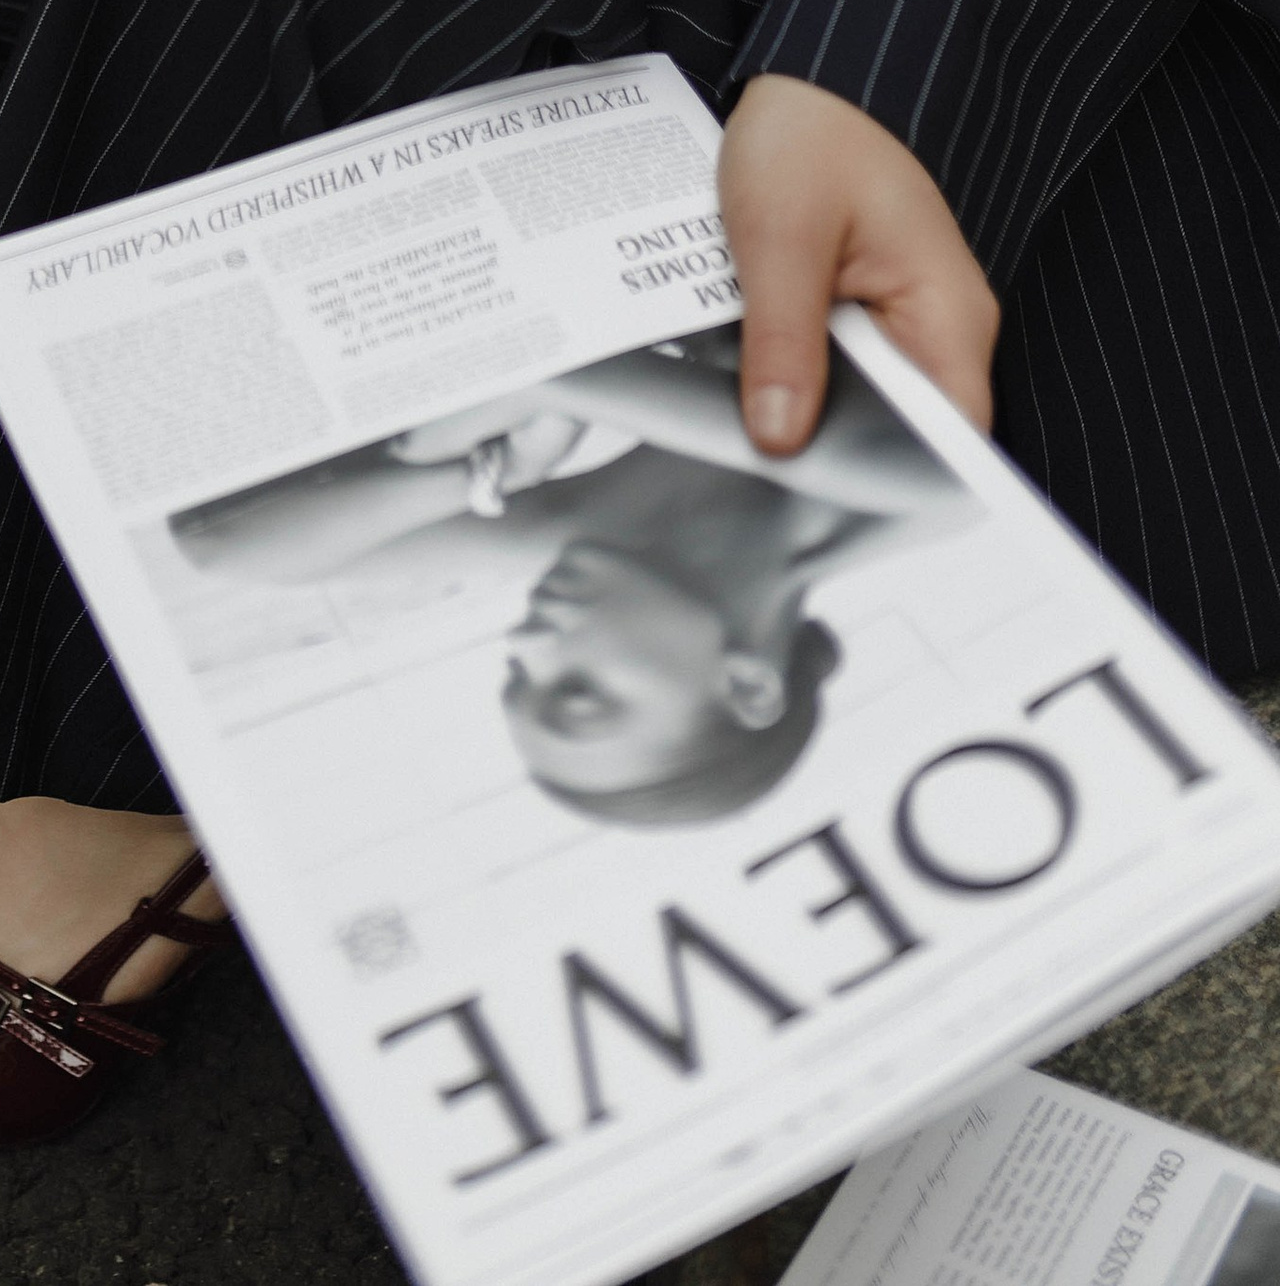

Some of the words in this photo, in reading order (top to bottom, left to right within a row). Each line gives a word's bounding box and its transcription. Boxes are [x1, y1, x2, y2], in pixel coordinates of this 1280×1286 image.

[527, 84, 650, 127] TEXTURE
[395, 143, 423, 170] IN
[426, 111, 525, 159] SPEAKS
[369, 153, 387, 177] A
[208, 160, 367, 233] WHISPERED
[27, 218, 202, 294] VOCABULARY
[616, 214, 723, 262] EELING
[621, 246, 730, 295] COMES
[693, 278, 743, 310] RM
[375, 654, 1217, 1191] LOEWE
[959, 1103, 996, 1140] When
[1126, 1149, 1185, 1226] GRACE
[1090, 1226, 1145, 1286] EXIS
